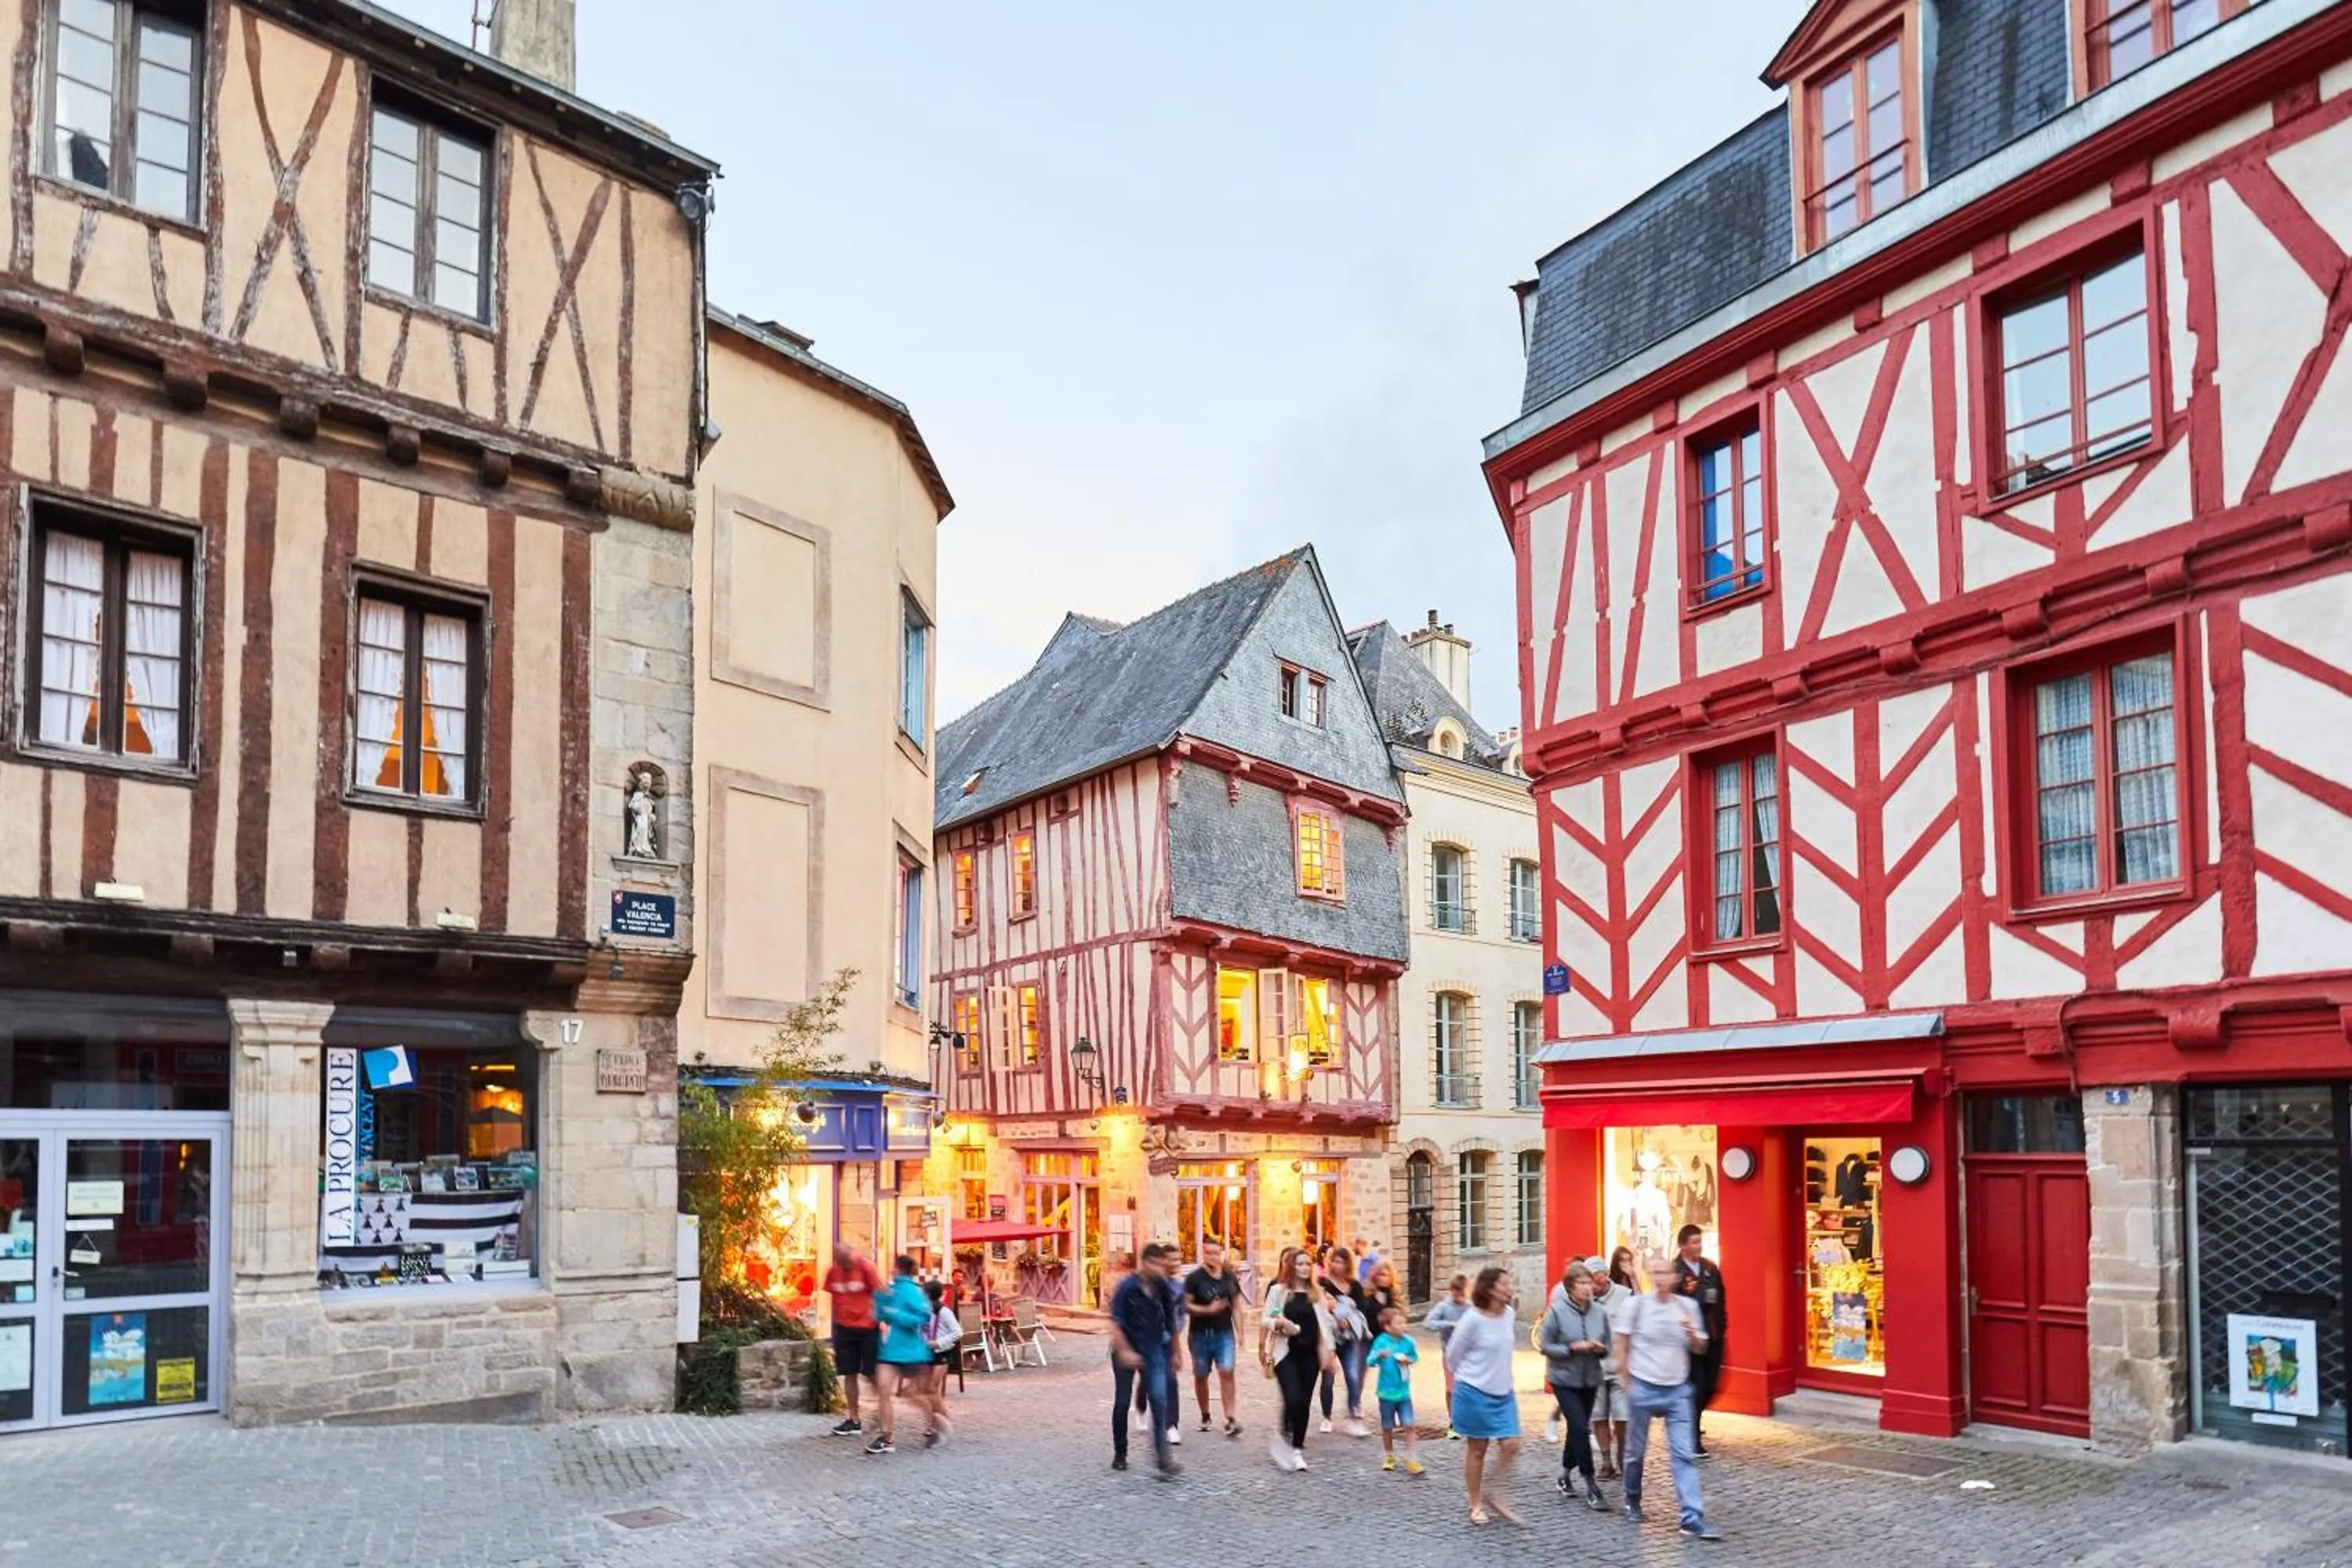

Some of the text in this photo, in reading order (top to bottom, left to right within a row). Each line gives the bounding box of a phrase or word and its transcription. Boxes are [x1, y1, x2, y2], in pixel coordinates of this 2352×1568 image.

[560, 1019, 584, 1044] 17
[327, 1053, 354, 1242] LA PROCURE
